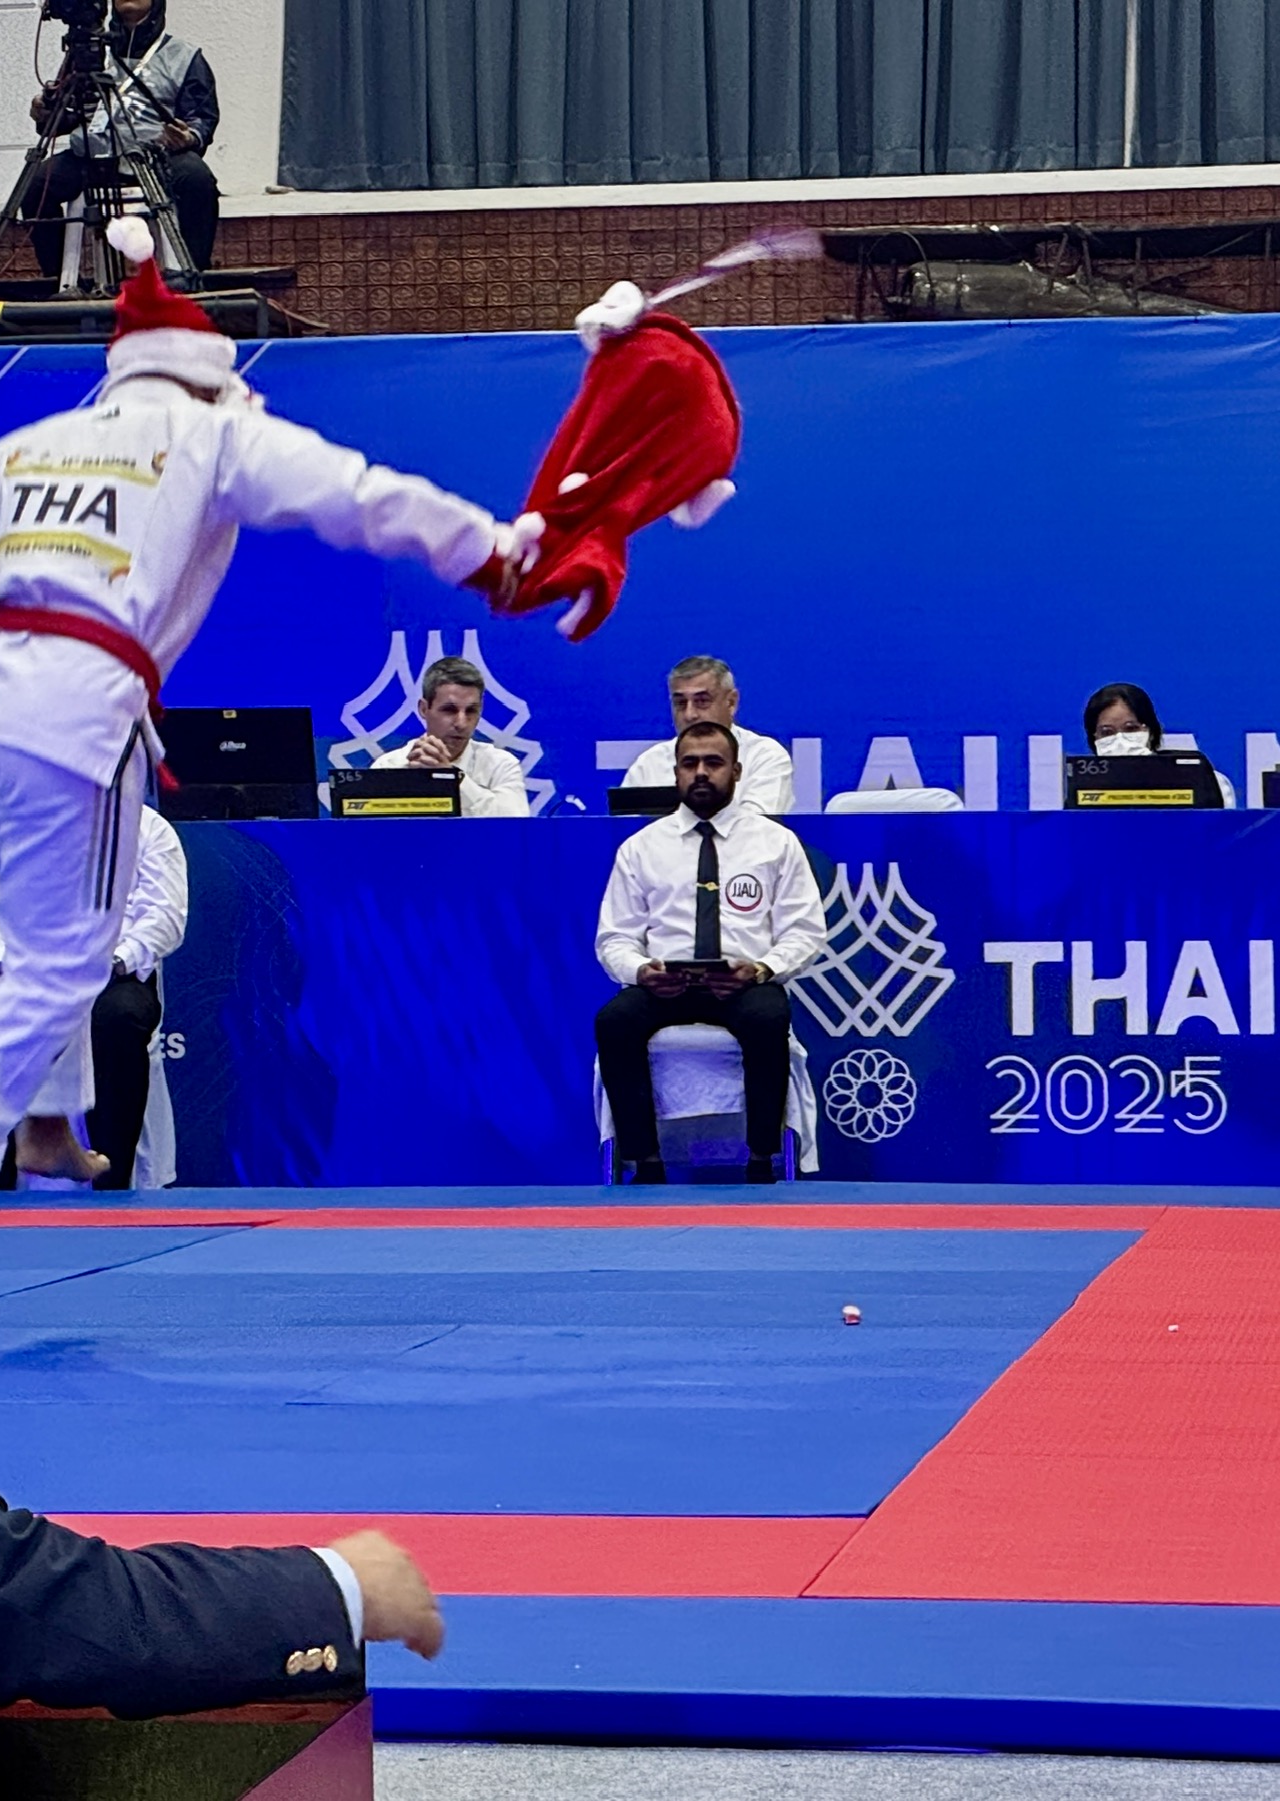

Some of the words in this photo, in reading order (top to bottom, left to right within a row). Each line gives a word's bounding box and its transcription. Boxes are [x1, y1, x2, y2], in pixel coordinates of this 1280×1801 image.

[12, 483, 117, 535] THA
[337, 770, 362, 783] 365
[1076, 759, 1109, 775] 363
[731, 882, 758, 899] JJAU
[983, 939, 1276, 1037] THAI
[985, 1054, 1228, 1135] 2025
